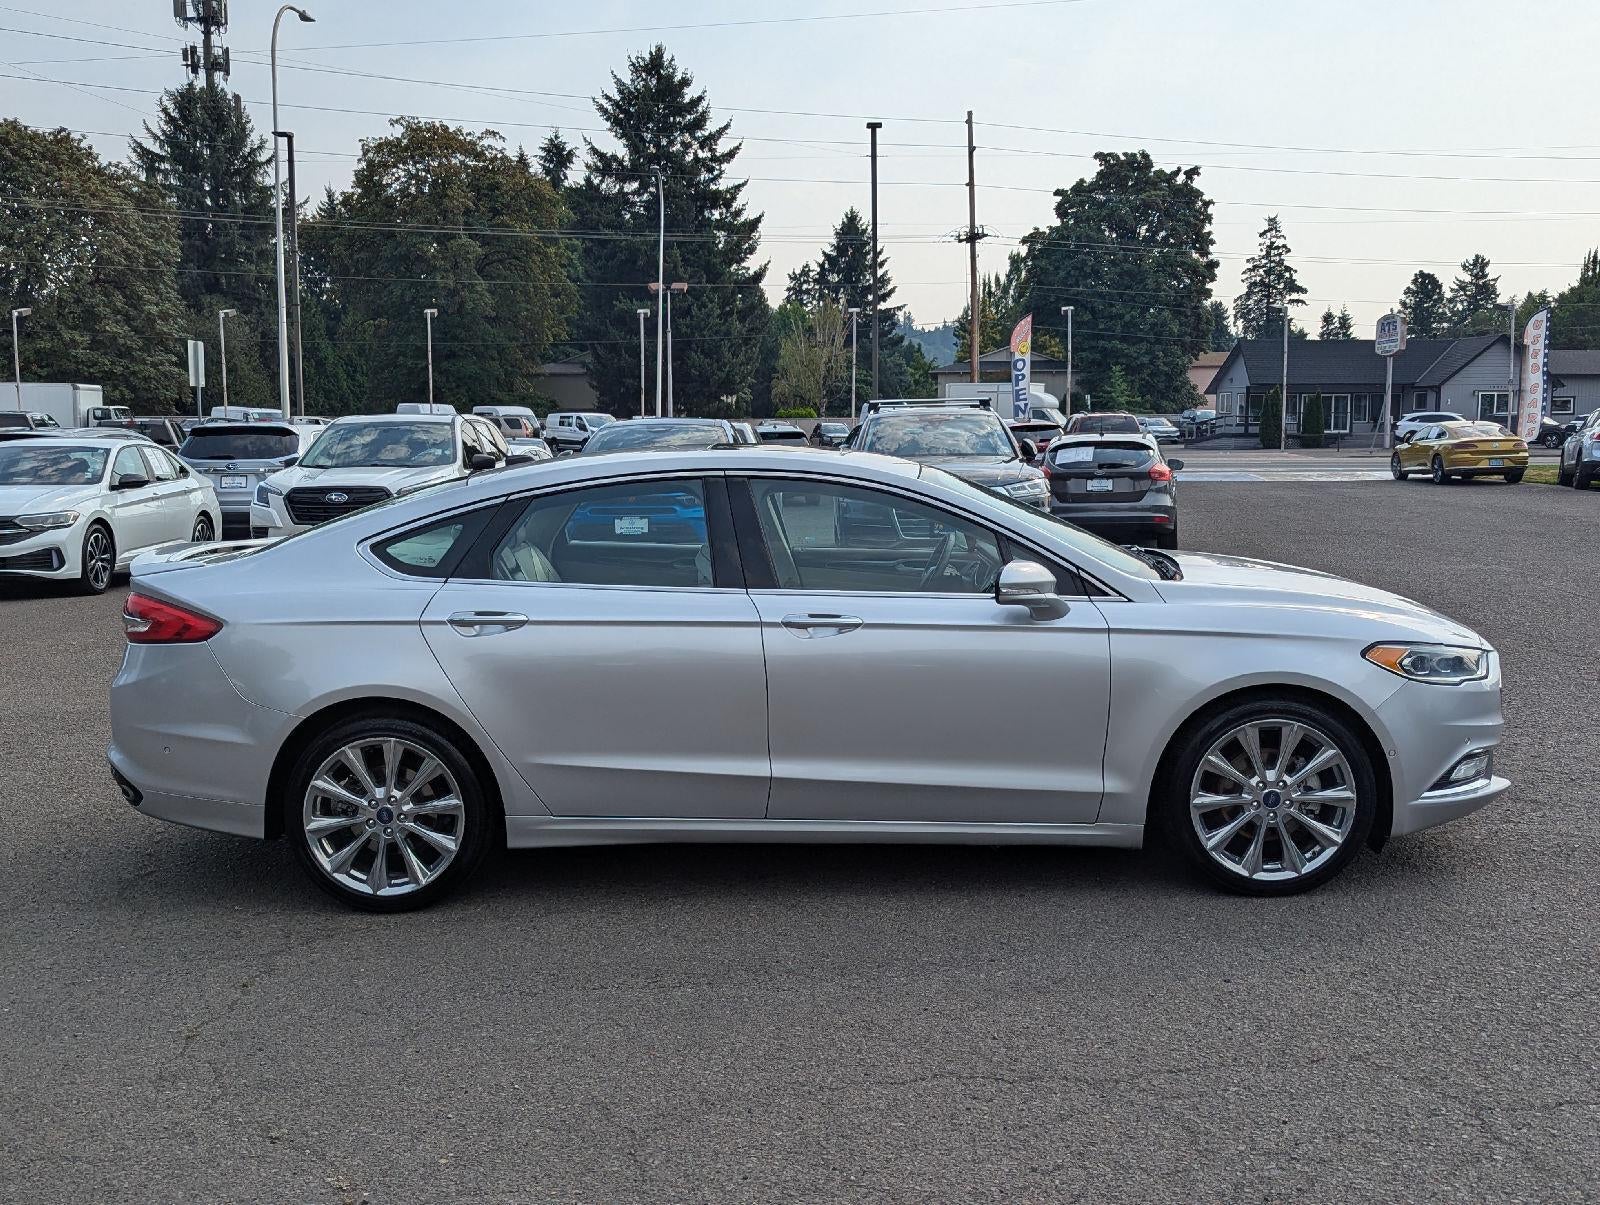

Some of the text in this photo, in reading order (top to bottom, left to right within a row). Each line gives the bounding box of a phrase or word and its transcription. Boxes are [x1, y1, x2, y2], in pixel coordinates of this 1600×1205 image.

[1013, 358, 1029, 418] OPEN
[1525, 319, 1543, 438] USED CARS
